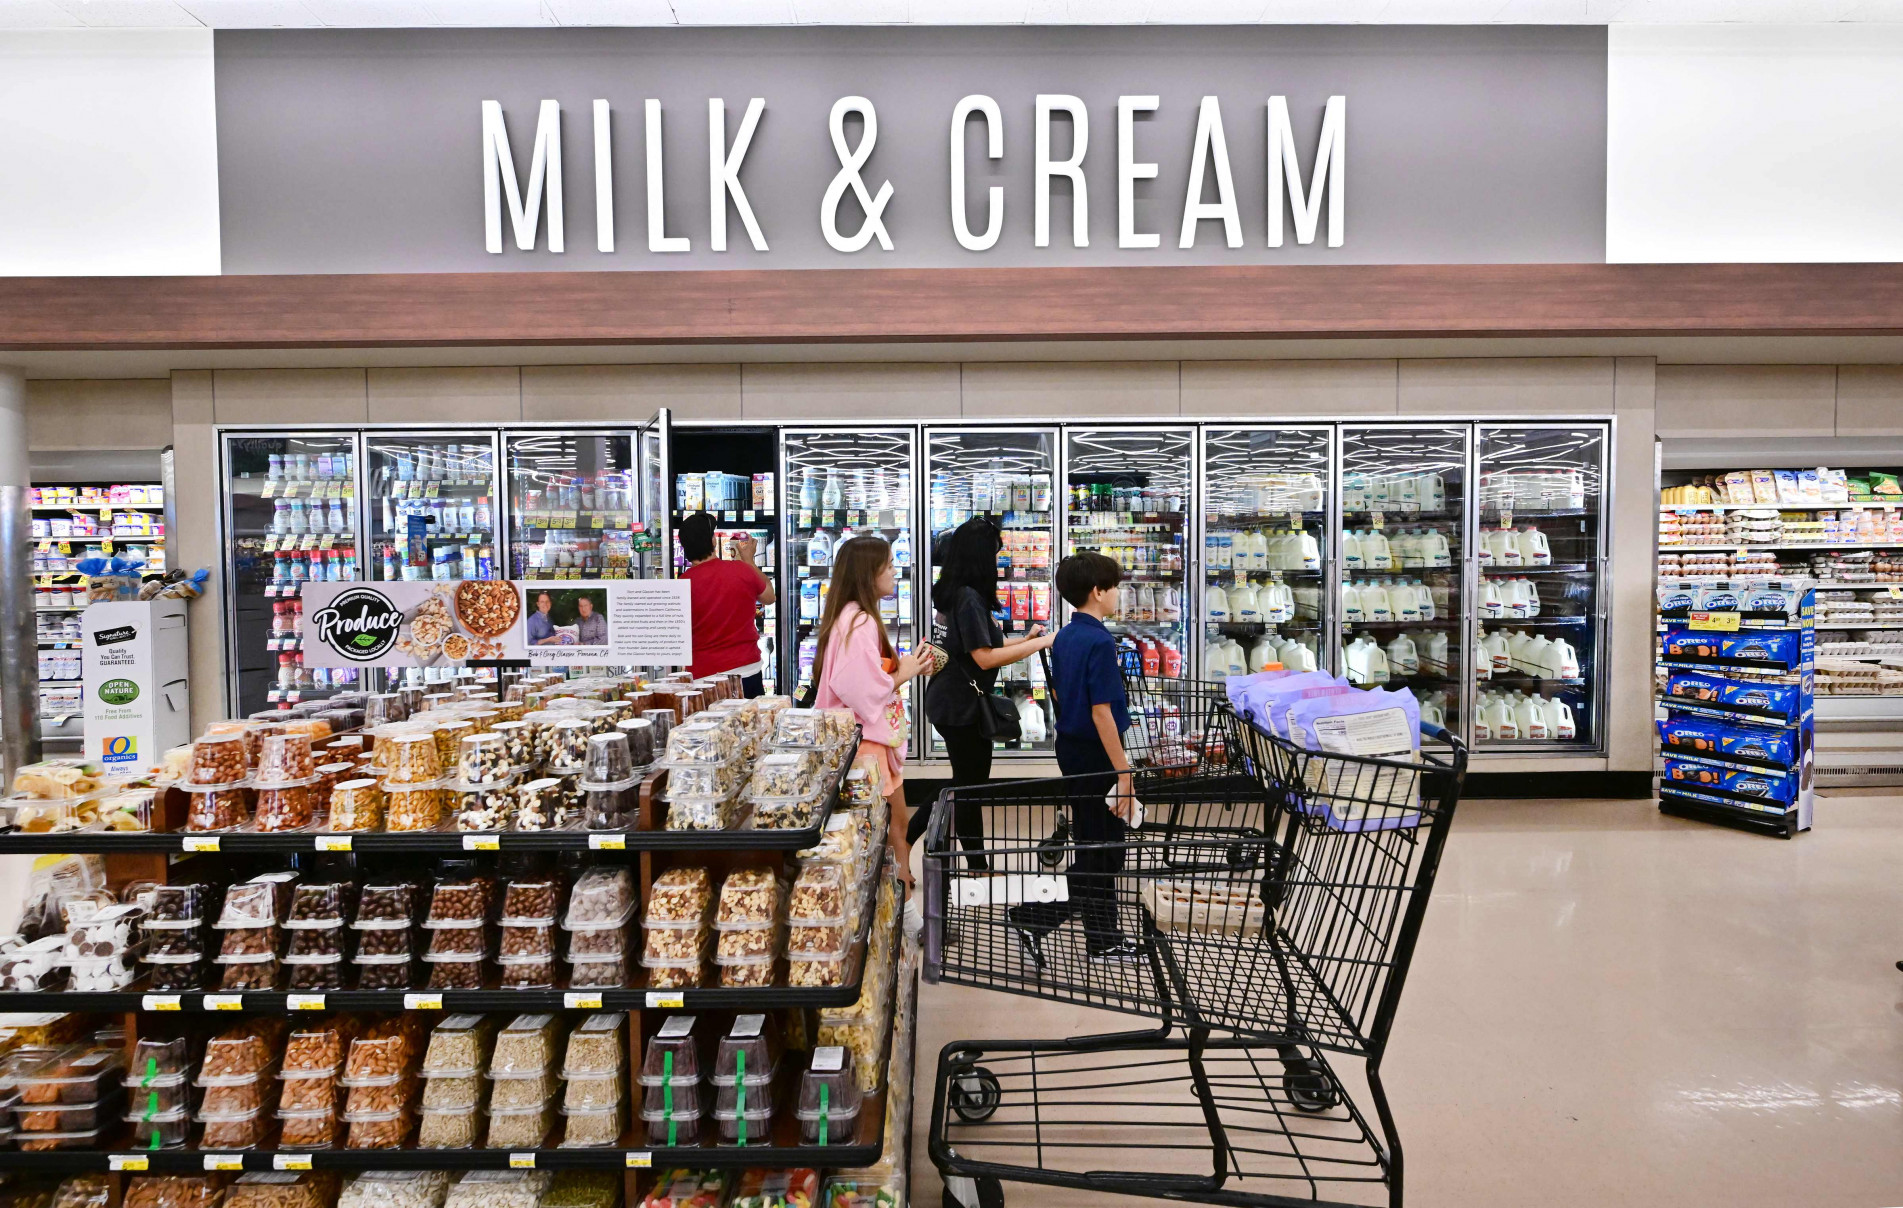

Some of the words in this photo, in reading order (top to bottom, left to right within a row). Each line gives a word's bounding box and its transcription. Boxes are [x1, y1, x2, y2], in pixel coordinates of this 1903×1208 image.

[481, 97, 769, 254] MILK
[820, 95, 895, 253] &
[950, 93, 1347, 252] CREAM
[340, 594, 360, 606] PREMIUM
[360, 594, 380, 604] QUALITY
[1663, 599, 1692, 609] OREO
[1706, 599, 1738, 608] OREO
[1751, 599, 1786, 608] OREO
[1802, 606, 1814, 616] SAVE
[315, 604, 402, 641] Produce
[1803, 619, 1813, 628] NOW
[98, 630, 130, 641] Signature
[345, 644, 368, 654] PACKAGED
[368, 639, 386, 653] LOCALLY
[607, 666, 632, 678] Silk
[109, 736, 131, 755] O
